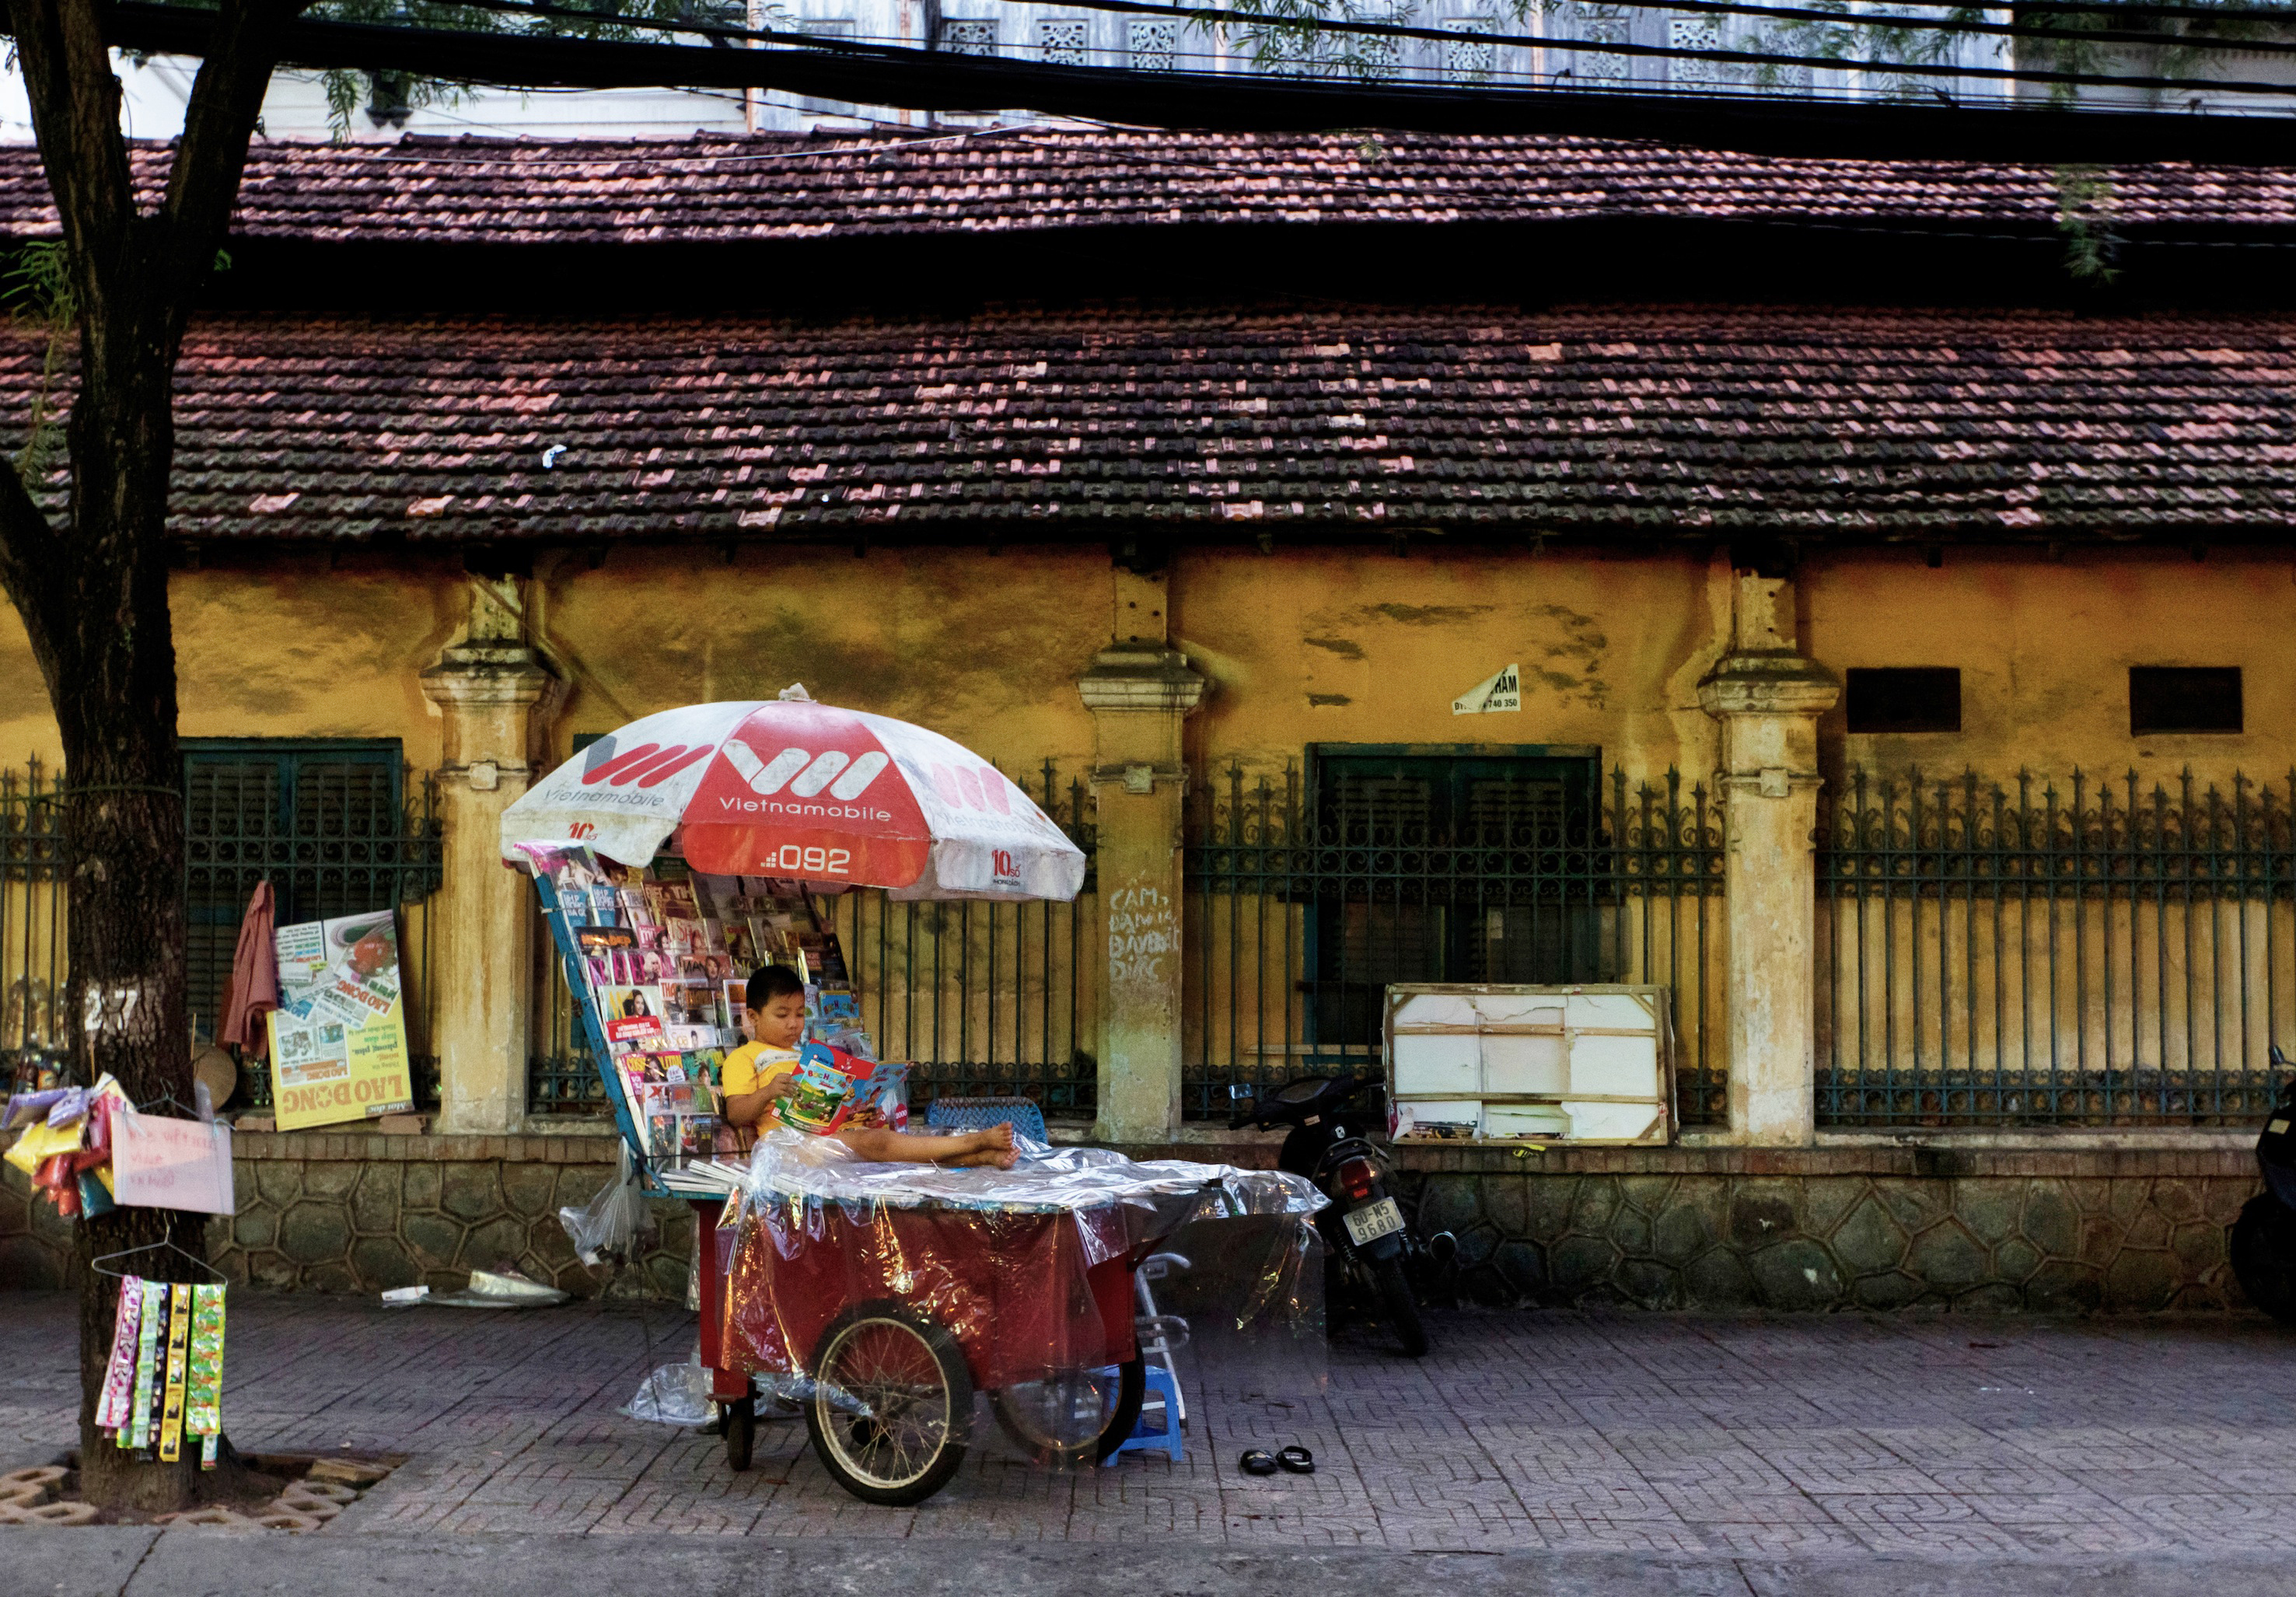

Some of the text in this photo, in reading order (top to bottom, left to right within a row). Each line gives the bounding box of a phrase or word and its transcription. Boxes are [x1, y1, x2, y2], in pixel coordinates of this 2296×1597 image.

[1504, 698, 1518, 708] 350
[544, 788, 665, 807] Vietnamobile
[720, 795, 892, 822] Vietnamobile
[778, 844, 851, 875] 092
[991, 848, 1011, 876] 10
[354, 1075, 404, 1103] LAO
[1353, 1202, 1390, 1228] 60-N5
[1358, 1216, 1396, 1242] 9680
